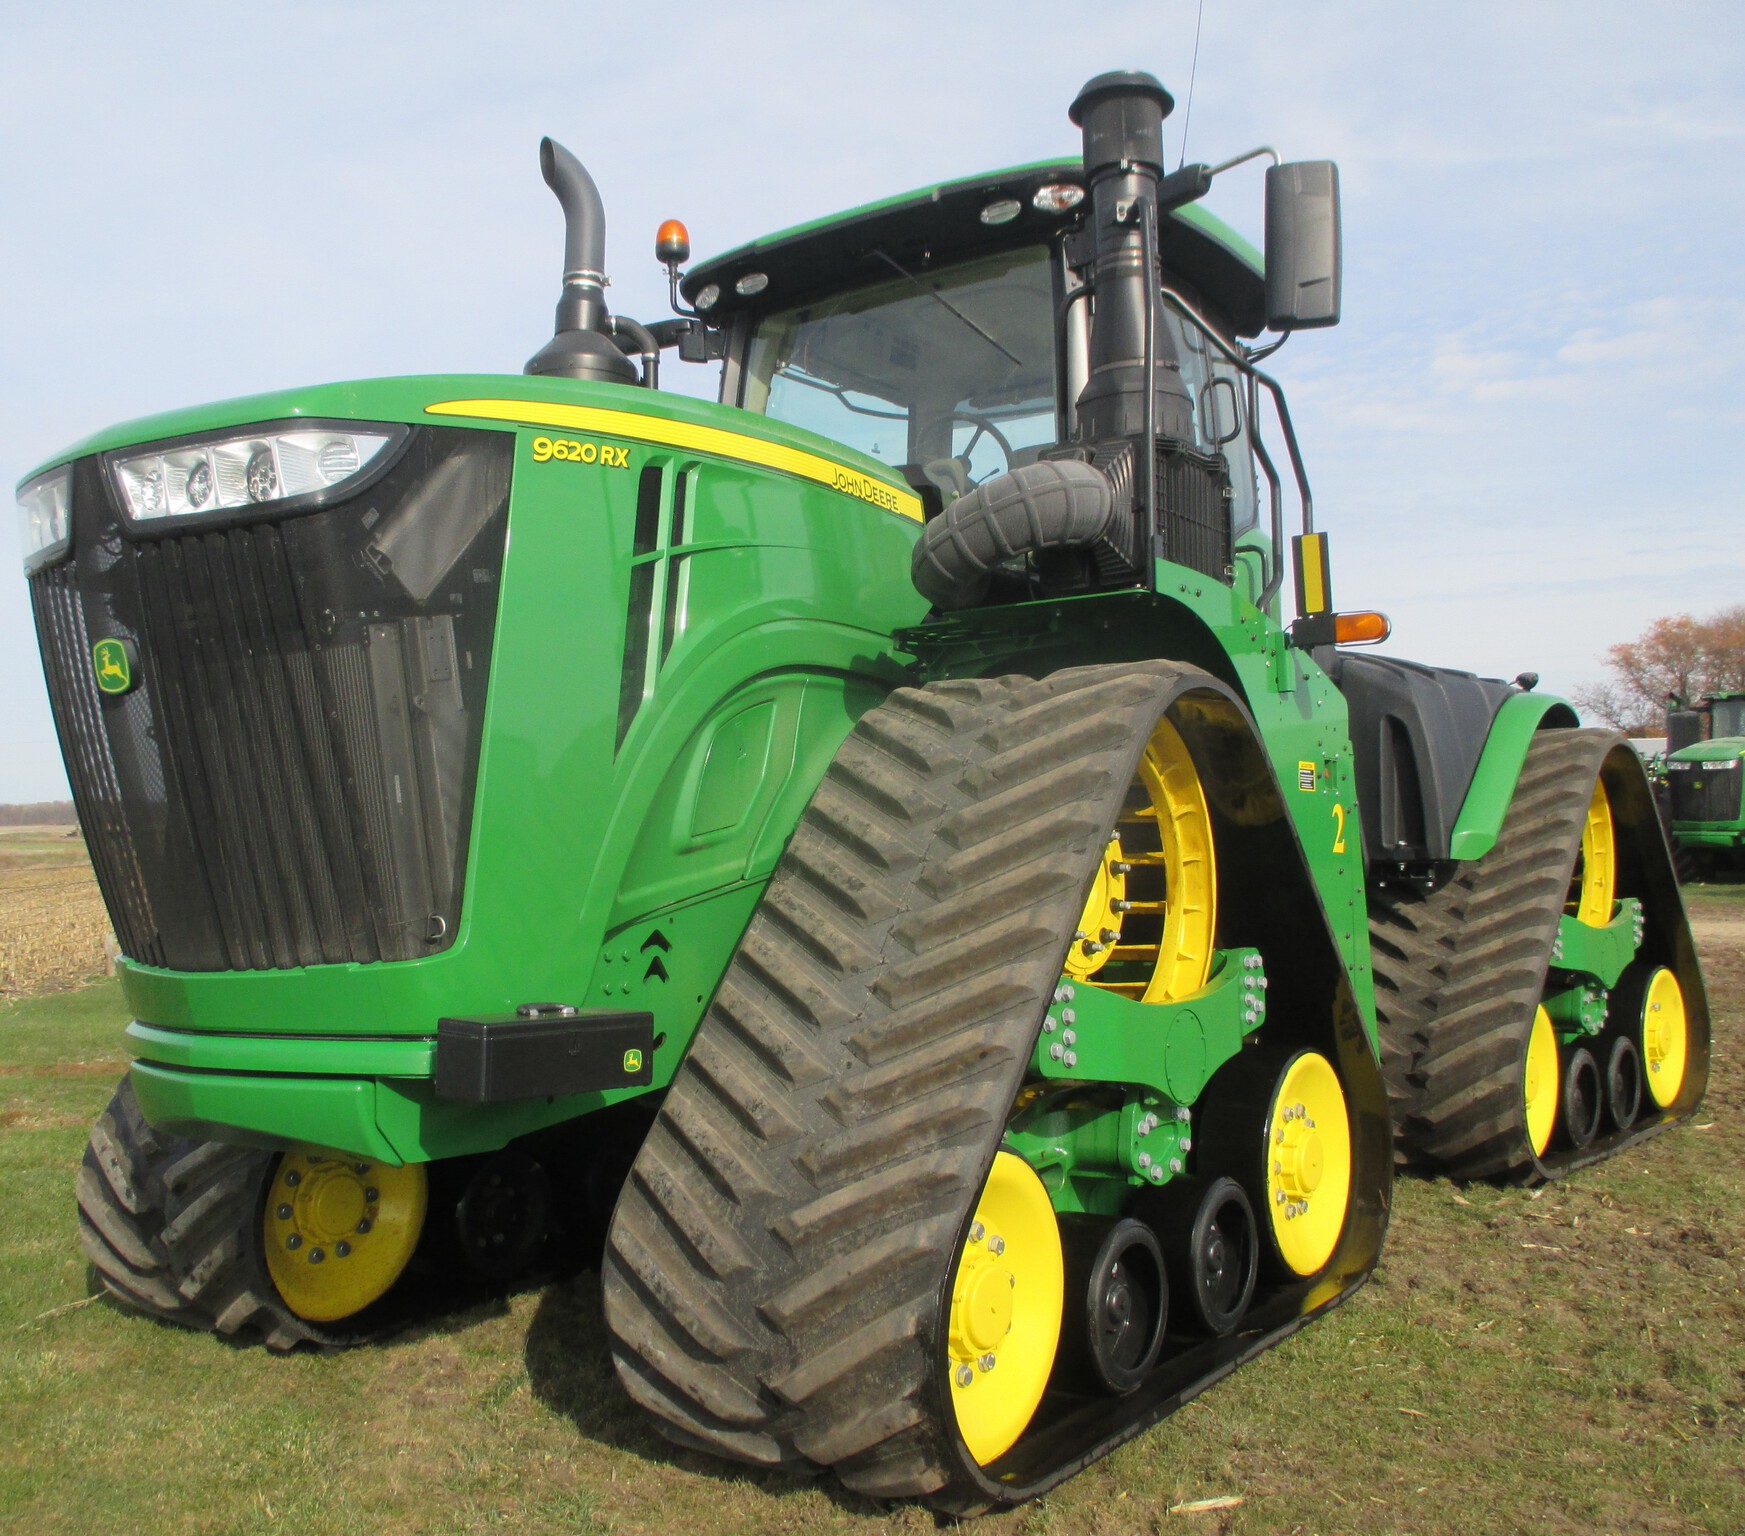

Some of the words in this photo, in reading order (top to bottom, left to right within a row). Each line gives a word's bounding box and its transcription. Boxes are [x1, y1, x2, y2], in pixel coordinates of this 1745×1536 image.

[533, 436, 597, 462] 9620
[600, 445, 629, 469] RX
[832, 467, 863, 498] JOHN
[863, 479, 899, 511] DEERE
[1332, 803, 1345, 853] 2
